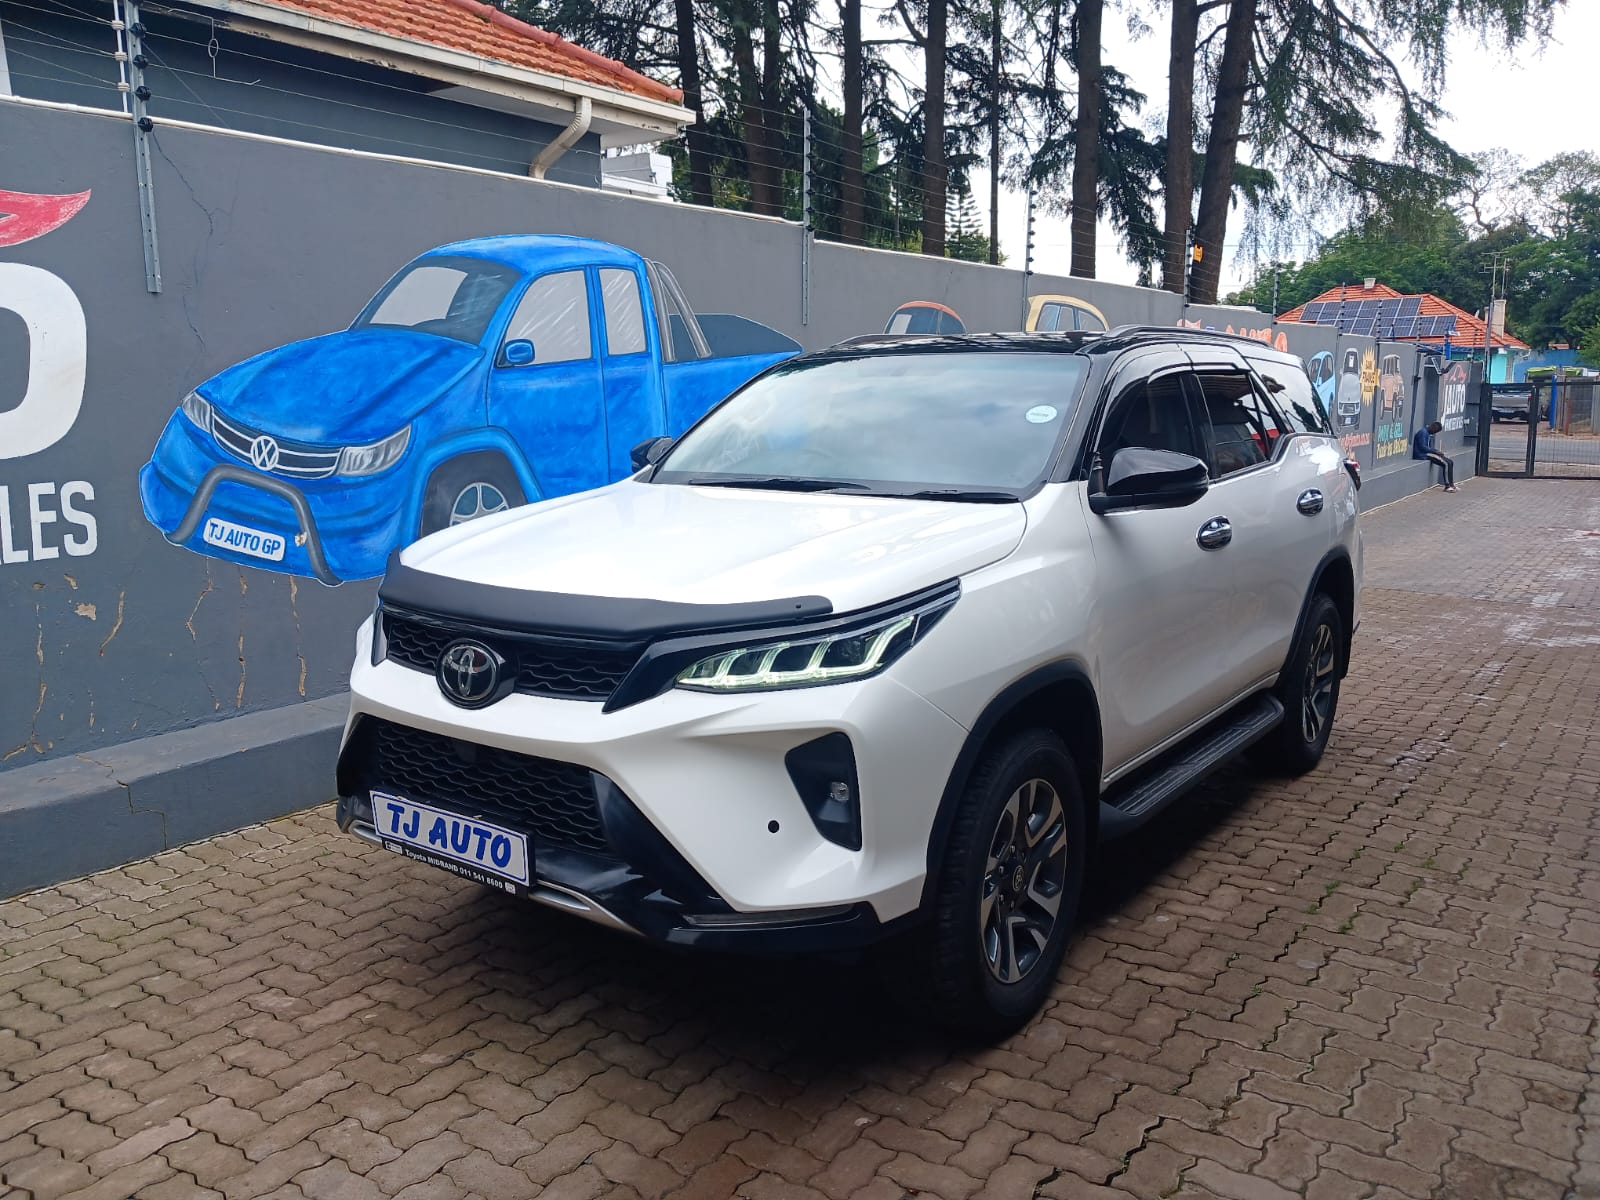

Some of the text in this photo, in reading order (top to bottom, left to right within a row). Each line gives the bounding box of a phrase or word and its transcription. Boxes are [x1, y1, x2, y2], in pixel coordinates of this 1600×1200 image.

[0, 480, 97, 565] LES
[210, 522, 281, 556] TJ AUTO GP
[387, 803, 512, 868] TJ AUTO
[405, 849, 427, 862] Toyota
[427, 856, 459, 872] MIDRAND
[460, 867, 472, 877] 011
